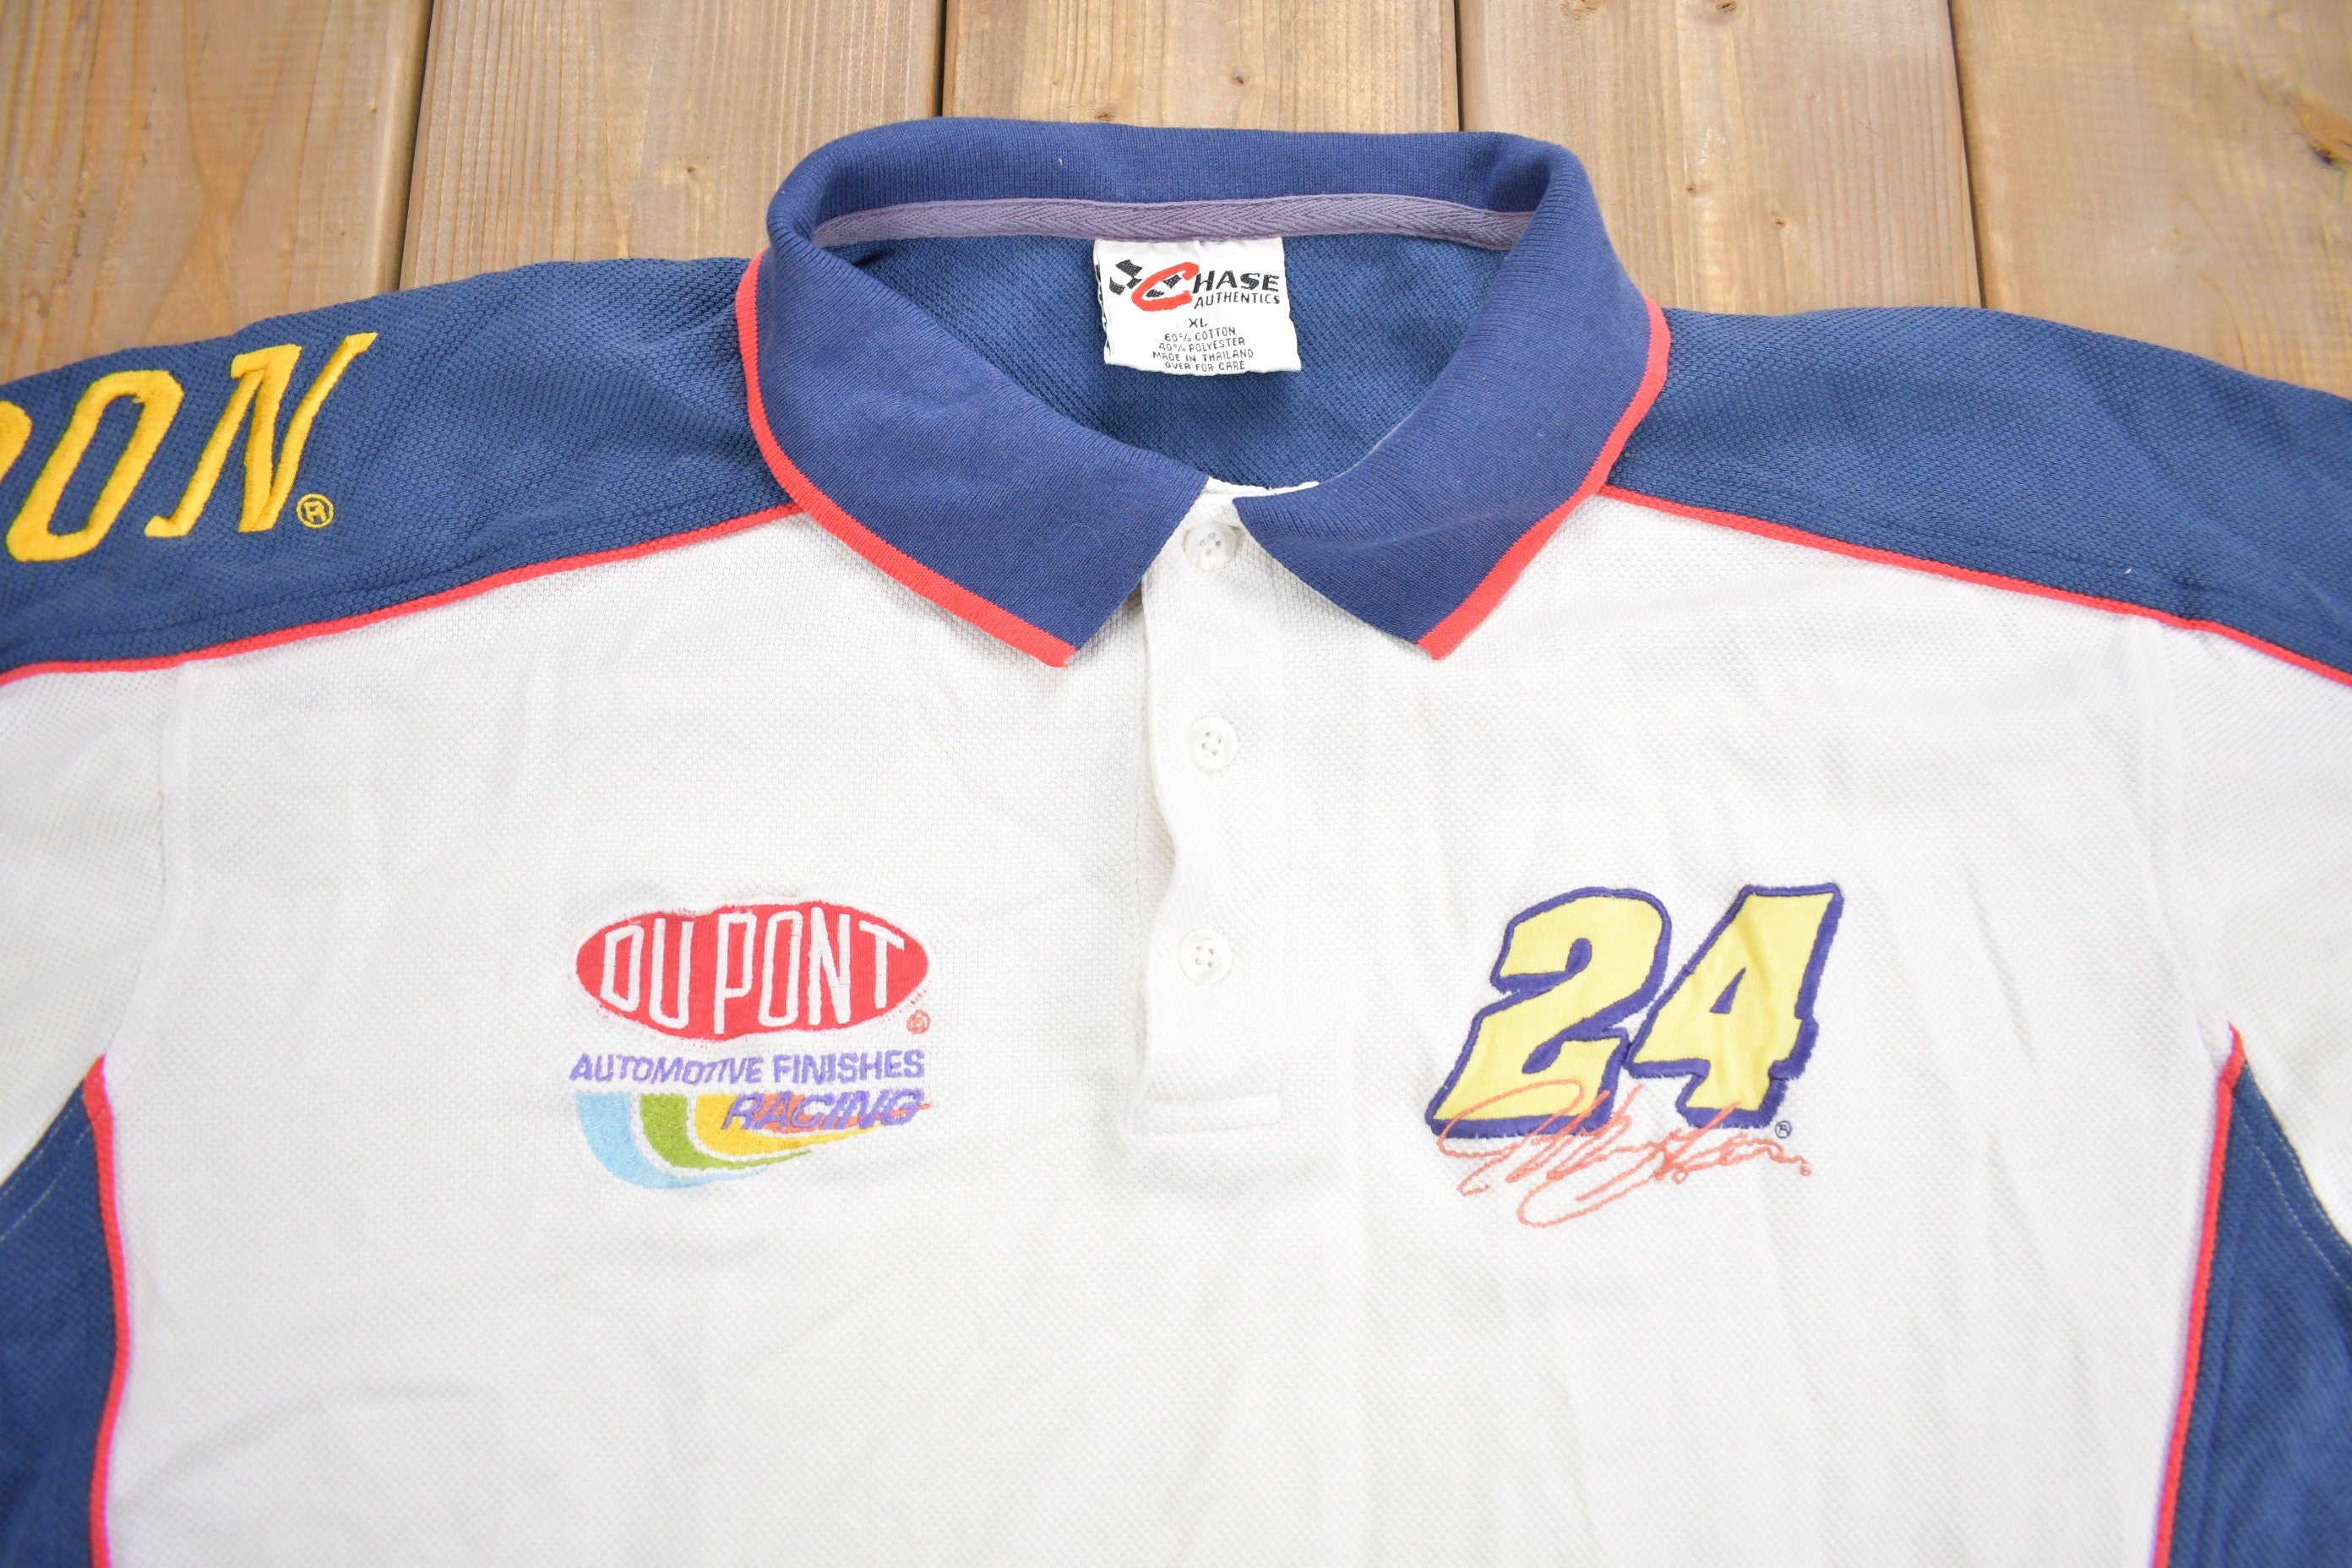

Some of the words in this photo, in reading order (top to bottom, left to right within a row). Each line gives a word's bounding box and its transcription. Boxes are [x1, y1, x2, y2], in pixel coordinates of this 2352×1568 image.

[1131, 262, 1279, 312] CHASE
[1194, 293, 1280, 309] AUTHENTICS
[1188, 318, 1208, 328] XL
[1164, 334, 1191, 342] 60%
[1195, 326, 1236, 340] COTTON
[1158, 343, 1186, 351] 40%
[1189, 337, 1245, 351] POLYESTER
[1152, 351, 1181, 362] MADE
[1201, 349, 1254, 362] THAILAND
[1164, 362, 1192, 370] OVER
[1195, 363, 1214, 372] FOR
[1218, 361, 1245, 370] CARE
[1424, 884, 1845, 1139] 24
[569, 1053, 762, 1086] AUTOMOTIVE
[772, 1049, 926, 1084] FINISHES
[721, 1088, 925, 1131] RACING
